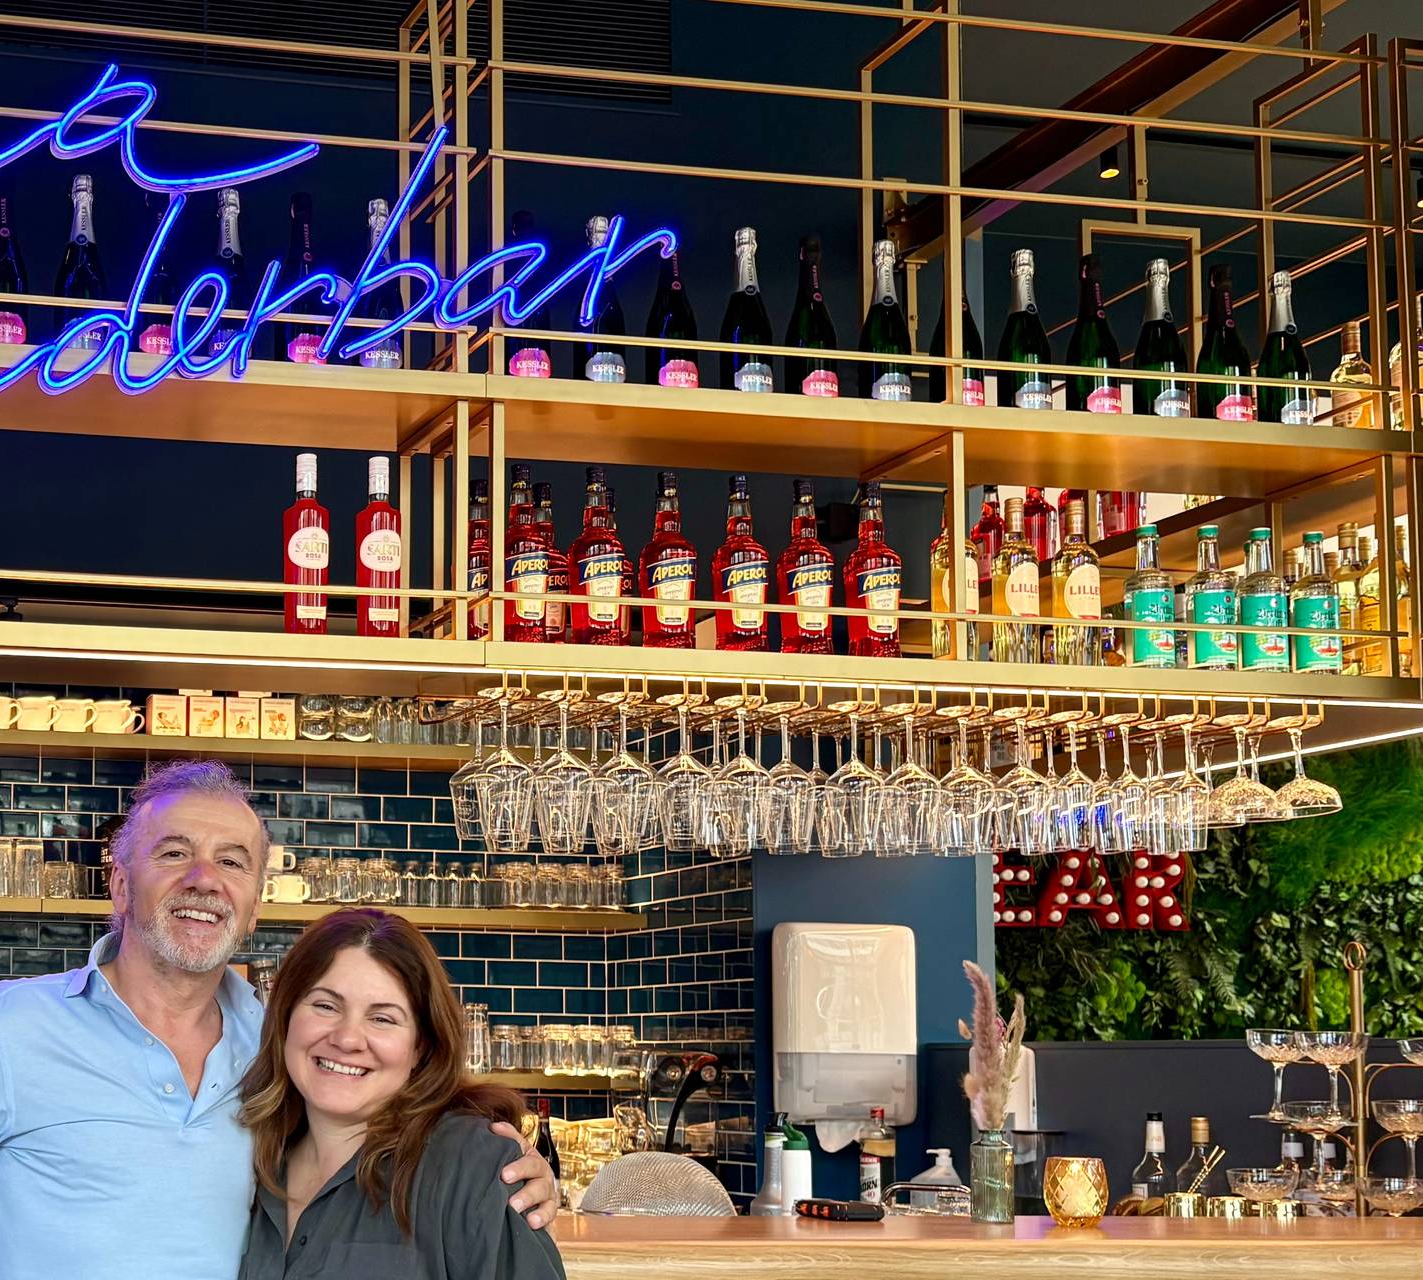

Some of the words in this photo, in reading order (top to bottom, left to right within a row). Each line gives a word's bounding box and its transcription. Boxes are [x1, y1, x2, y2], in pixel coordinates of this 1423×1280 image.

[146, 337, 172, 347] KESSL
[295, 346, 318, 355] KESS
[365, 351, 399, 361] KESSLER
[516, 360, 549, 371] KESSLER
[592, 364, 624, 375] KESSLER
[665, 371, 698, 382] KESSLER
[742, 374, 773, 385] KESSLER
[584, 561, 623, 578] APEROL
[653, 563, 693, 583] APEROL
[727, 567, 767, 586] APEROL
[793, 570, 832, 589] APEROL
[1011, 584, 1039, 594] LILLE
[1070, 586, 1100, 595] LILLE
